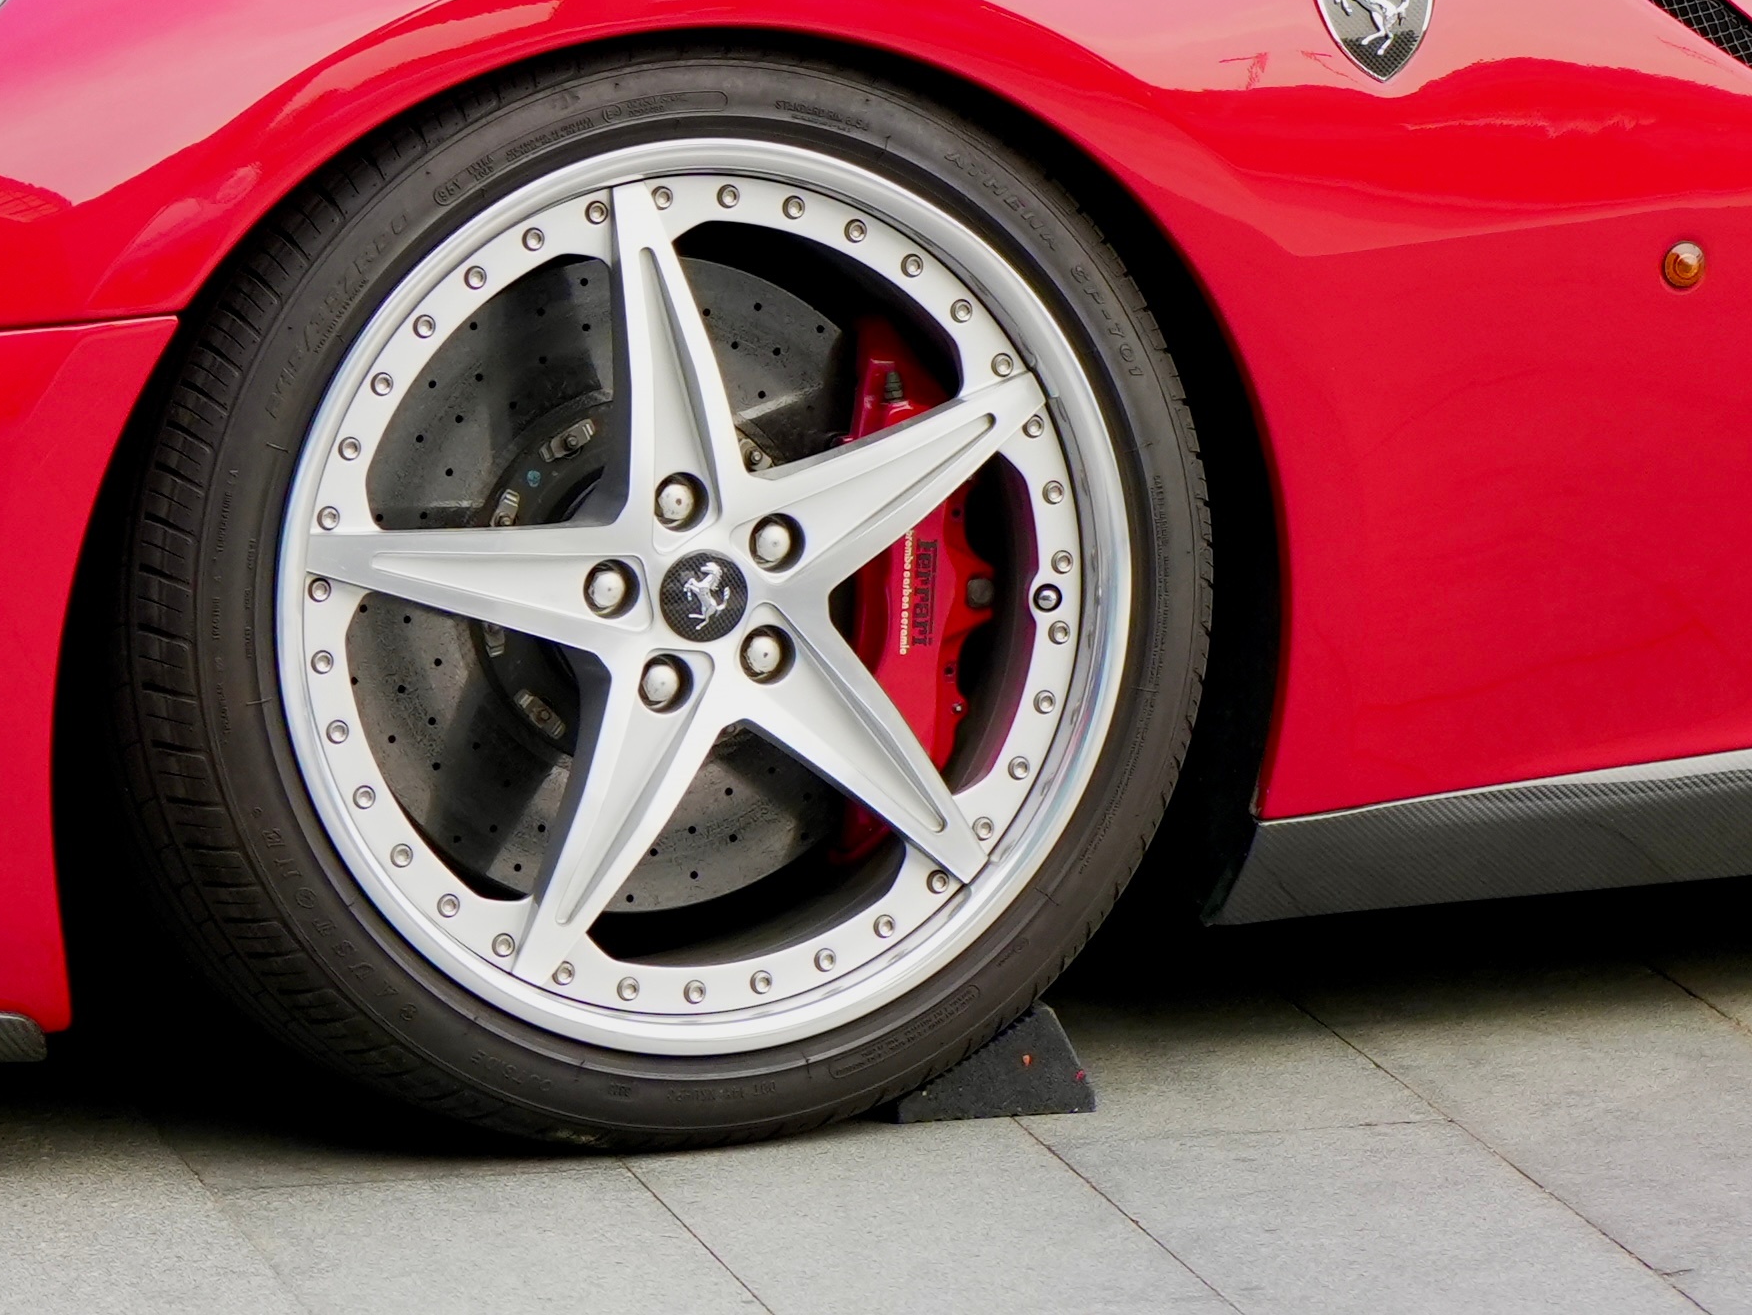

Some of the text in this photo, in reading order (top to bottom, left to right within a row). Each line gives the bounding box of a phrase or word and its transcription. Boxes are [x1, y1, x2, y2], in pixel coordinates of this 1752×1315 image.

[945, 150, 1057, 252] ATHENA
[901, 571, 913, 609] carbon
[912, 539, 938, 646] Ferrari
[899, 611, 911, 656] ceramic
